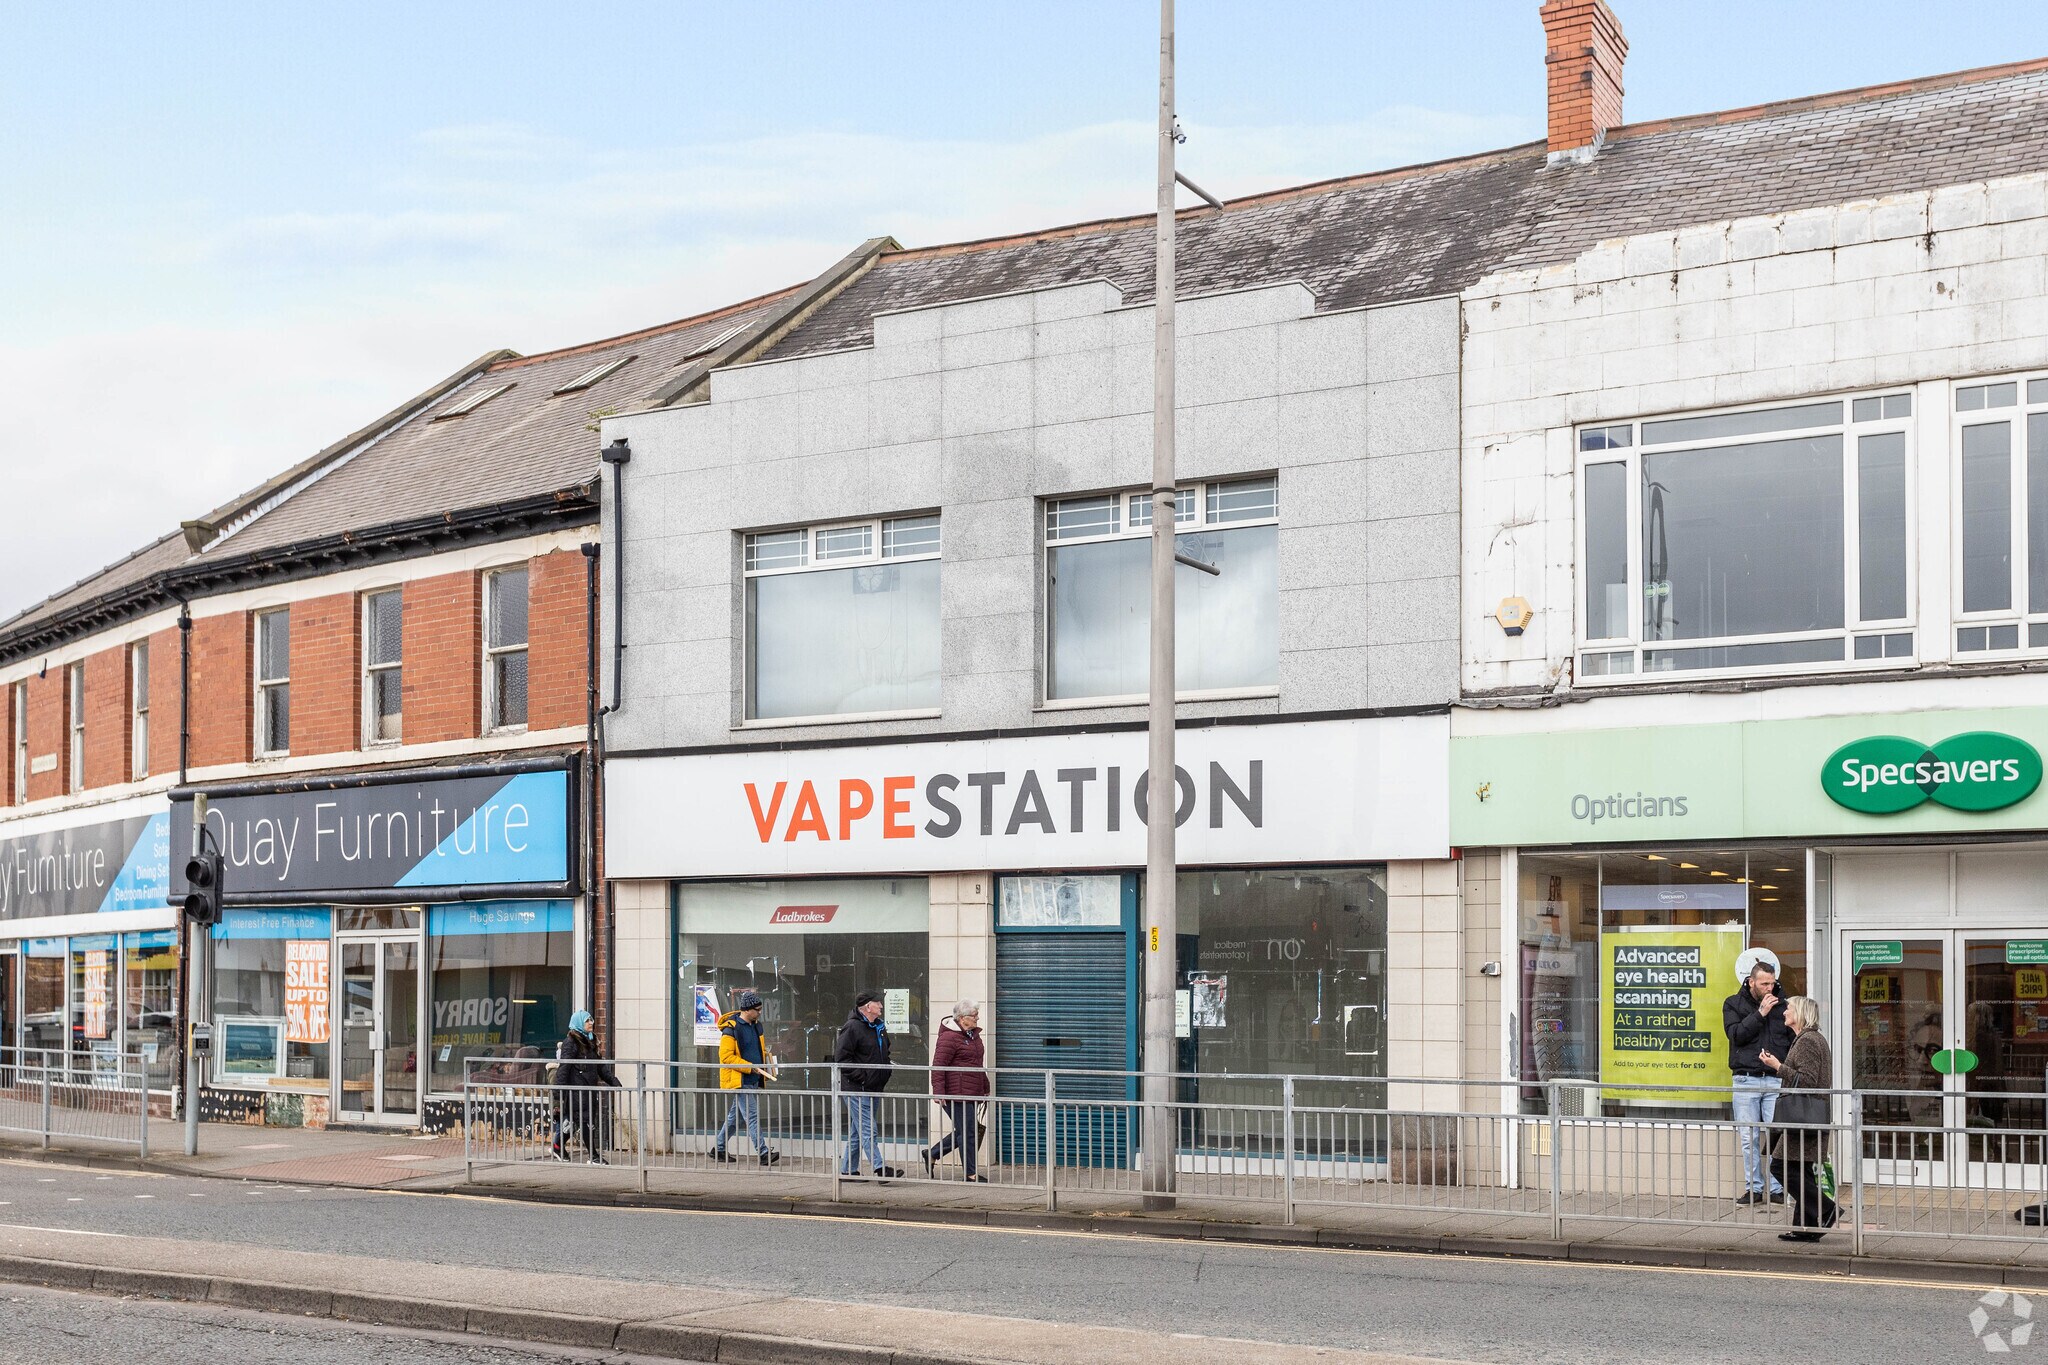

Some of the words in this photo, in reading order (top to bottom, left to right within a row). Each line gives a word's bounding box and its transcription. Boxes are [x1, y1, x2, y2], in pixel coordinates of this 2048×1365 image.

[1842, 757, 2020, 793] Specsavers
[1571, 791, 1688, 824] Opticians
[316, 792, 529, 862] Furniture
[154, 842, 170, 858] Sofa
[16, 840, 105, 895] Furniture
[136, 866, 157, 882] Dining
[157, 863, 170, 878] Set
[115, 887, 143, 902] Bedroom
[143, 885, 169, 900] Furnitur
[230, 917, 260, 929] Interest
[261, 917, 280, 929] Free
[282, 916, 315, 929] Finance
[469, 911, 494, 926] Huge
[496, 909, 535, 927] Savings
[776, 911, 825, 923] Ladbrokes
[288, 943, 328, 961] RELOCATION
[1615, 948, 1699, 964] Advanced
[287, 962, 327, 988] SALE
[1615, 971, 1643, 986] eye
[1647, 968, 1704, 984] health
[1615, 989, 1691, 1008] scanning
[287, 1003, 309, 1040] 50%
[309, 1003, 327, 1040] OFF
[1615, 1013, 1632, 1025] At
[1634, 1015, 1643, 1026] a
[1646, 1013, 1694, 1027] rather
[1614, 1034, 1666, 1051] healthy
[1670, 1035, 1710, 1051] price
[1665, 1061, 1679, 1069] test
[1680, 1061, 1692, 1069] for
